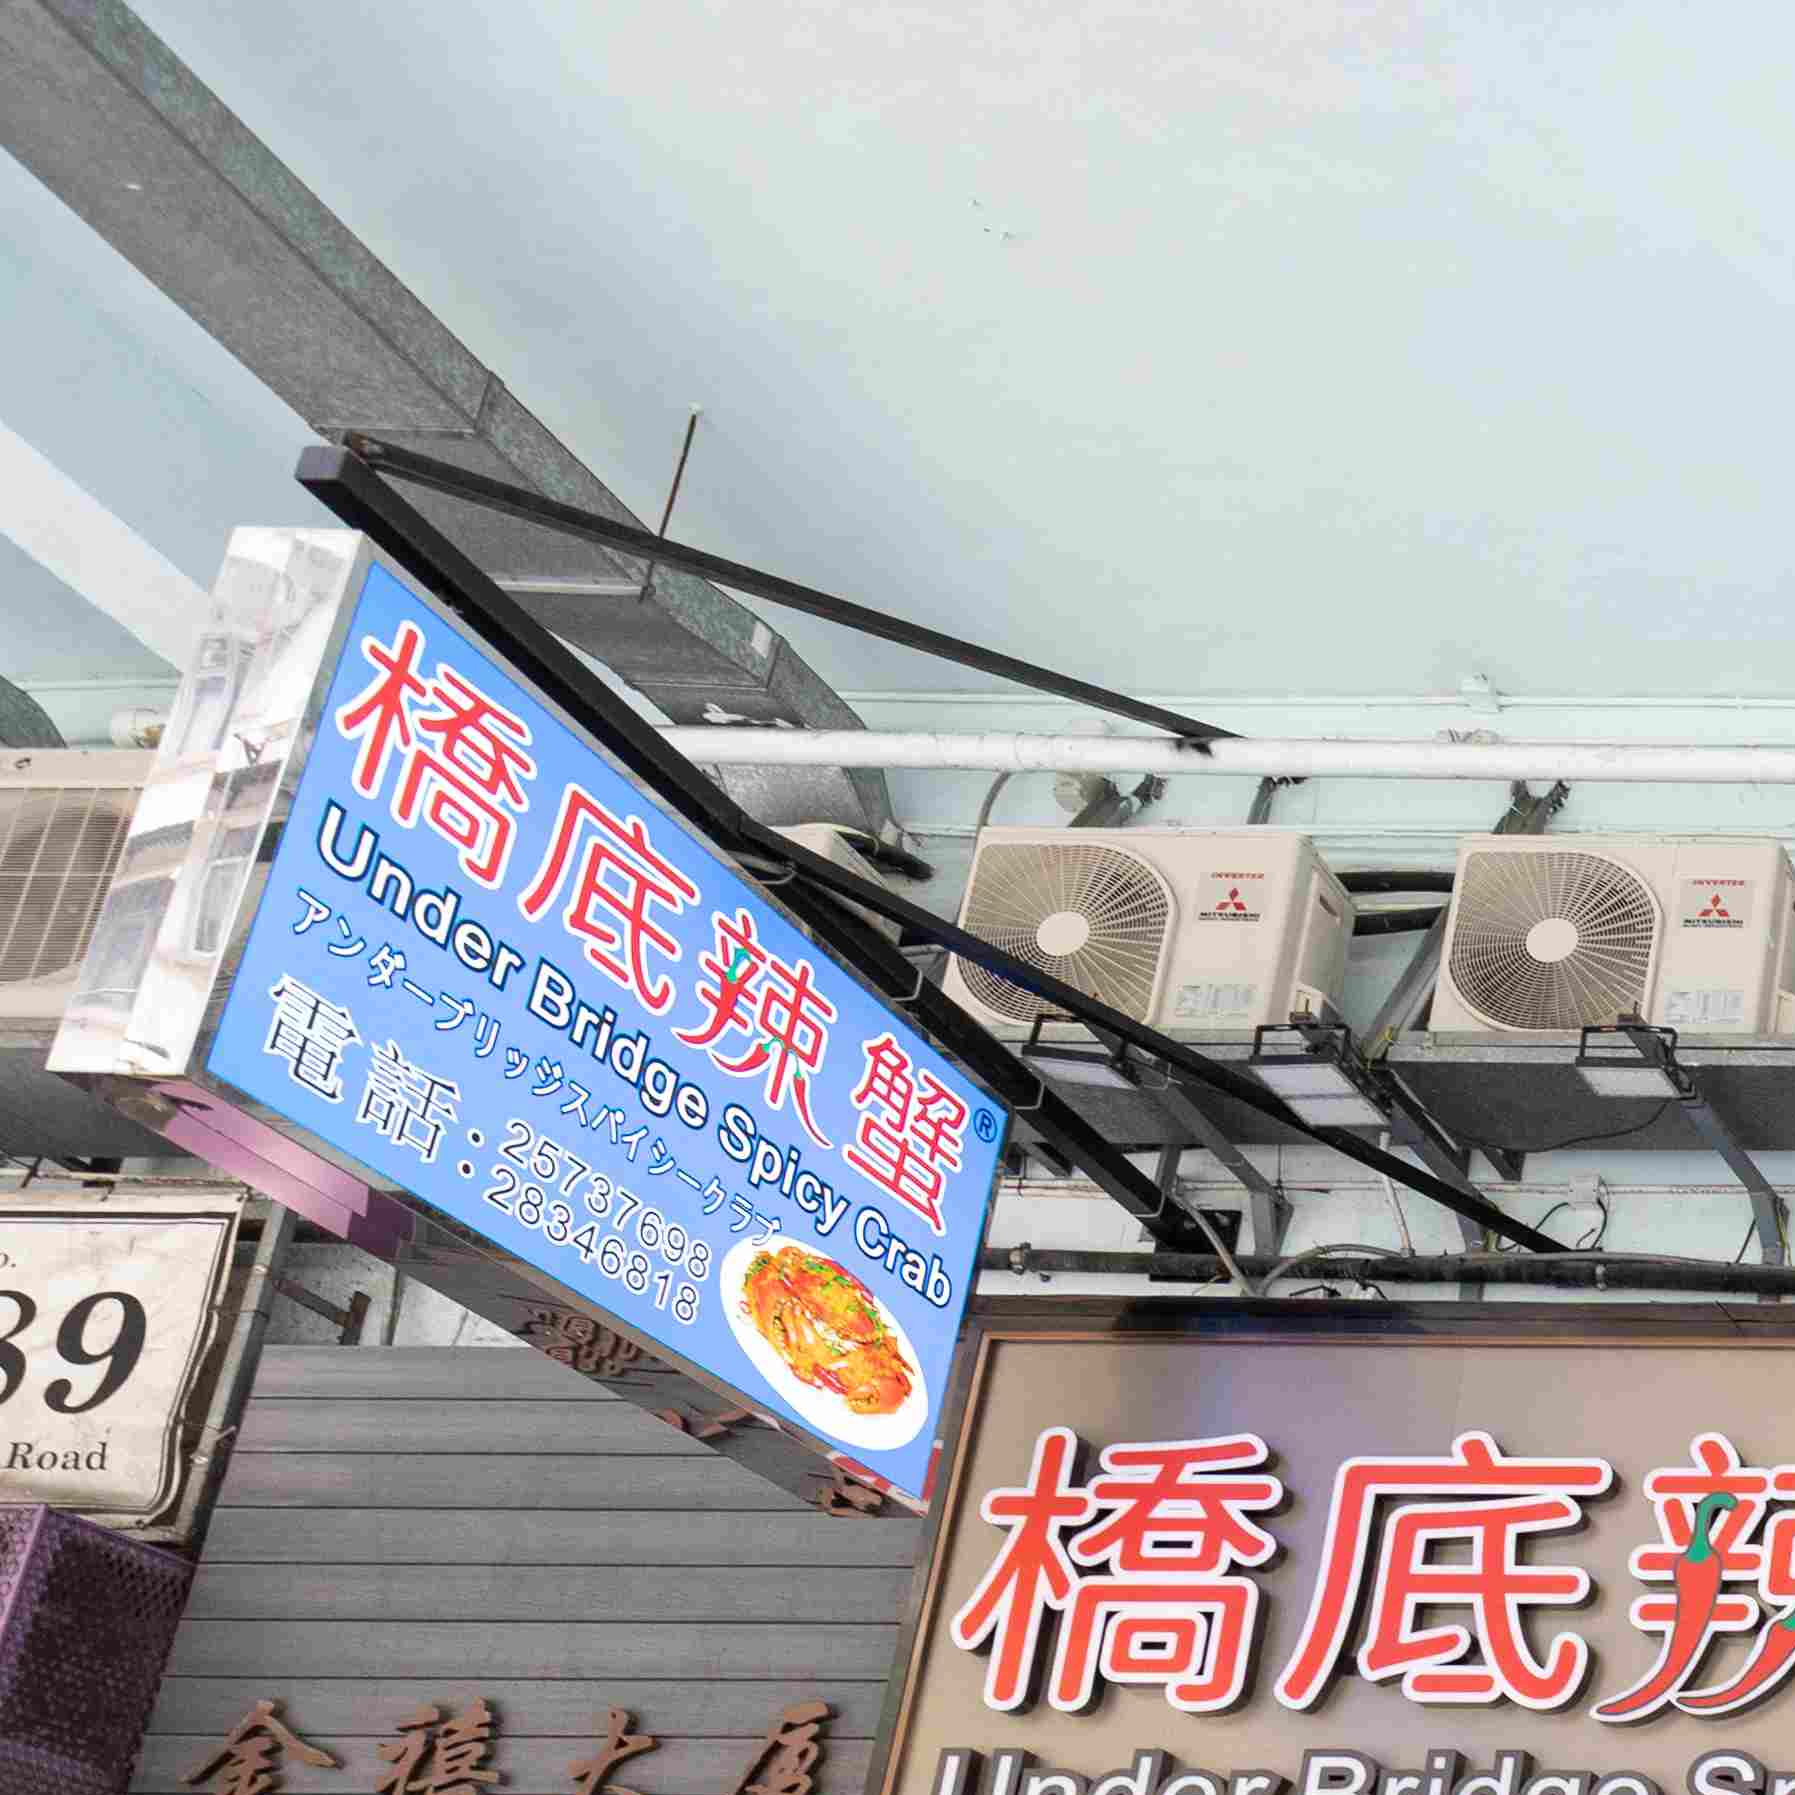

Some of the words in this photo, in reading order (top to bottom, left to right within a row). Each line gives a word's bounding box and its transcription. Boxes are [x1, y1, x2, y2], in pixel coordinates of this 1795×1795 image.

[335, 618, 967, 1236] 橋底辣蟹
[316, 800, 524, 1000] Under
[526, 957, 709, 1133] Bridge
[716, 1100, 849, 1232] Spicy
[852, 1204, 954, 1309] Crab
[485, 1168, 699, 1325] 28346818
[503, 1120, 711, 1279] 25737698
[6, 1442, 107, 1472] Road
